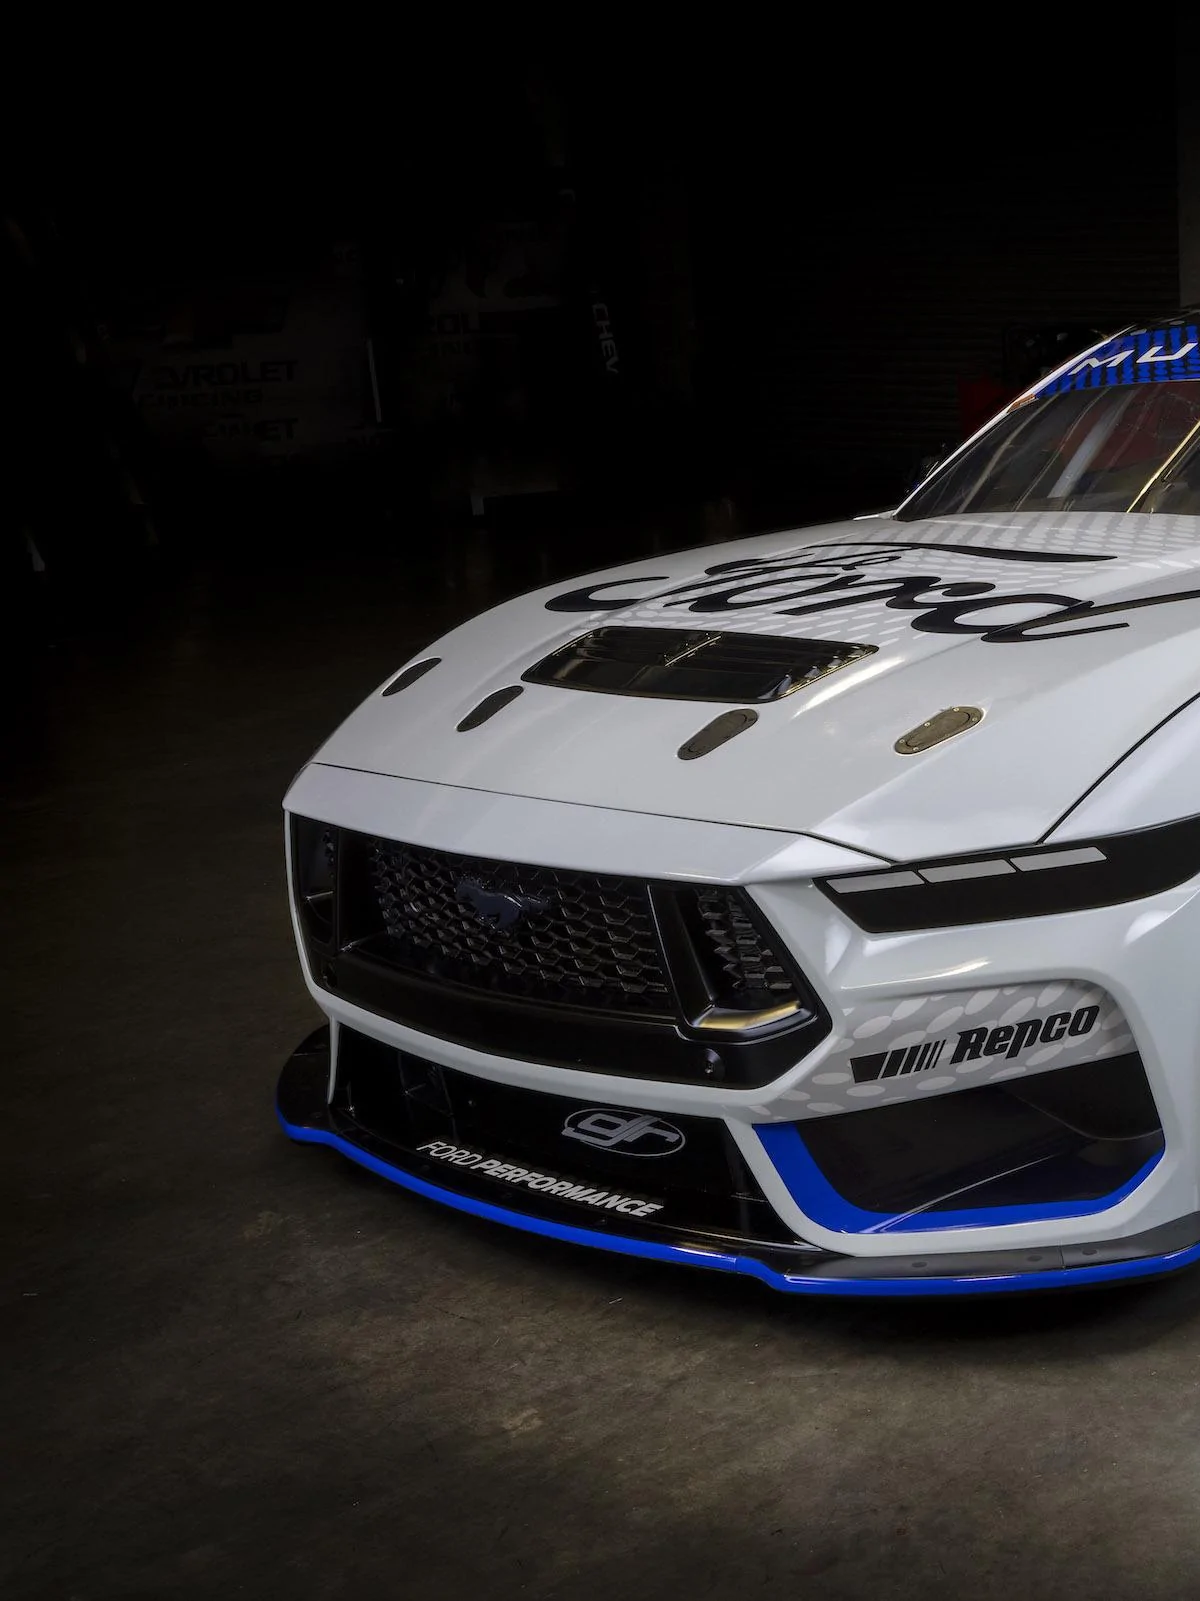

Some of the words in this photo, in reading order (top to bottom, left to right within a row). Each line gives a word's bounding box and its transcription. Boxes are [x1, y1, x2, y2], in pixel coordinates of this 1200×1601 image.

[592, 303, 620, 374] CHEV
[949, 1005, 1100, 1066] Repco
[416, 1141, 482, 1166] FORD
[470, 1159, 665, 1217] PERFORMANCE
